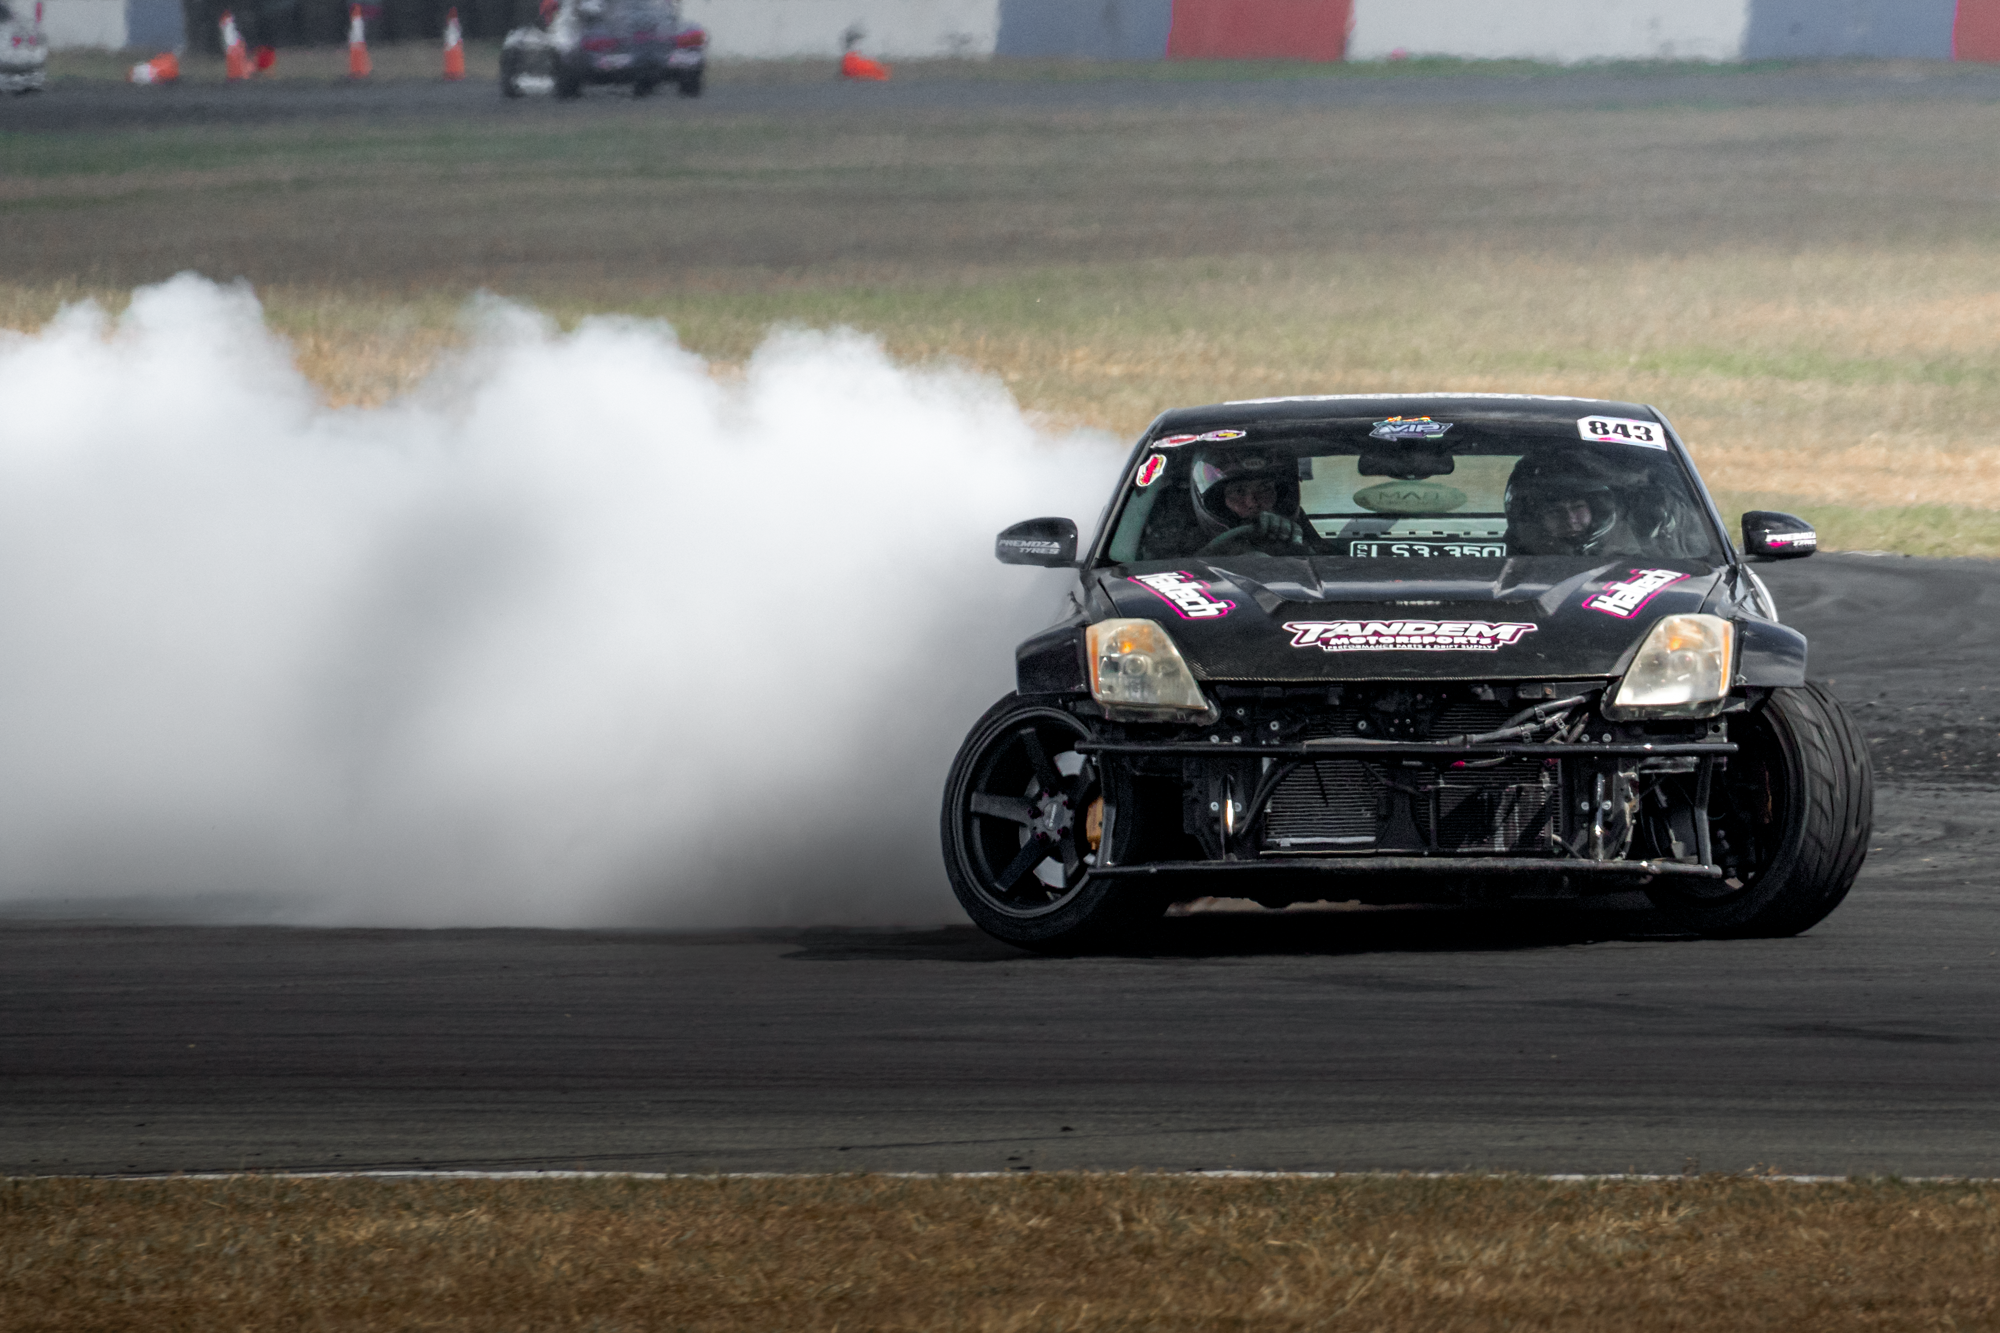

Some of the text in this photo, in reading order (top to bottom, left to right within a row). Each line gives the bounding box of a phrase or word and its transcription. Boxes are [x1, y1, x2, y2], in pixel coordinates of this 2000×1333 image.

[1379, 422, 1441, 434] VIP
[1588, 420, 1655, 442] 843
[1020, 547, 1060, 555] TYRES
[1135, 572, 1228, 617] Haltech
[1590, 569, 1683, 616] Haltech
[1292, 622, 1528, 643] TANDEM
[1329, 636, 1492, 645] MOTORSPORTS
